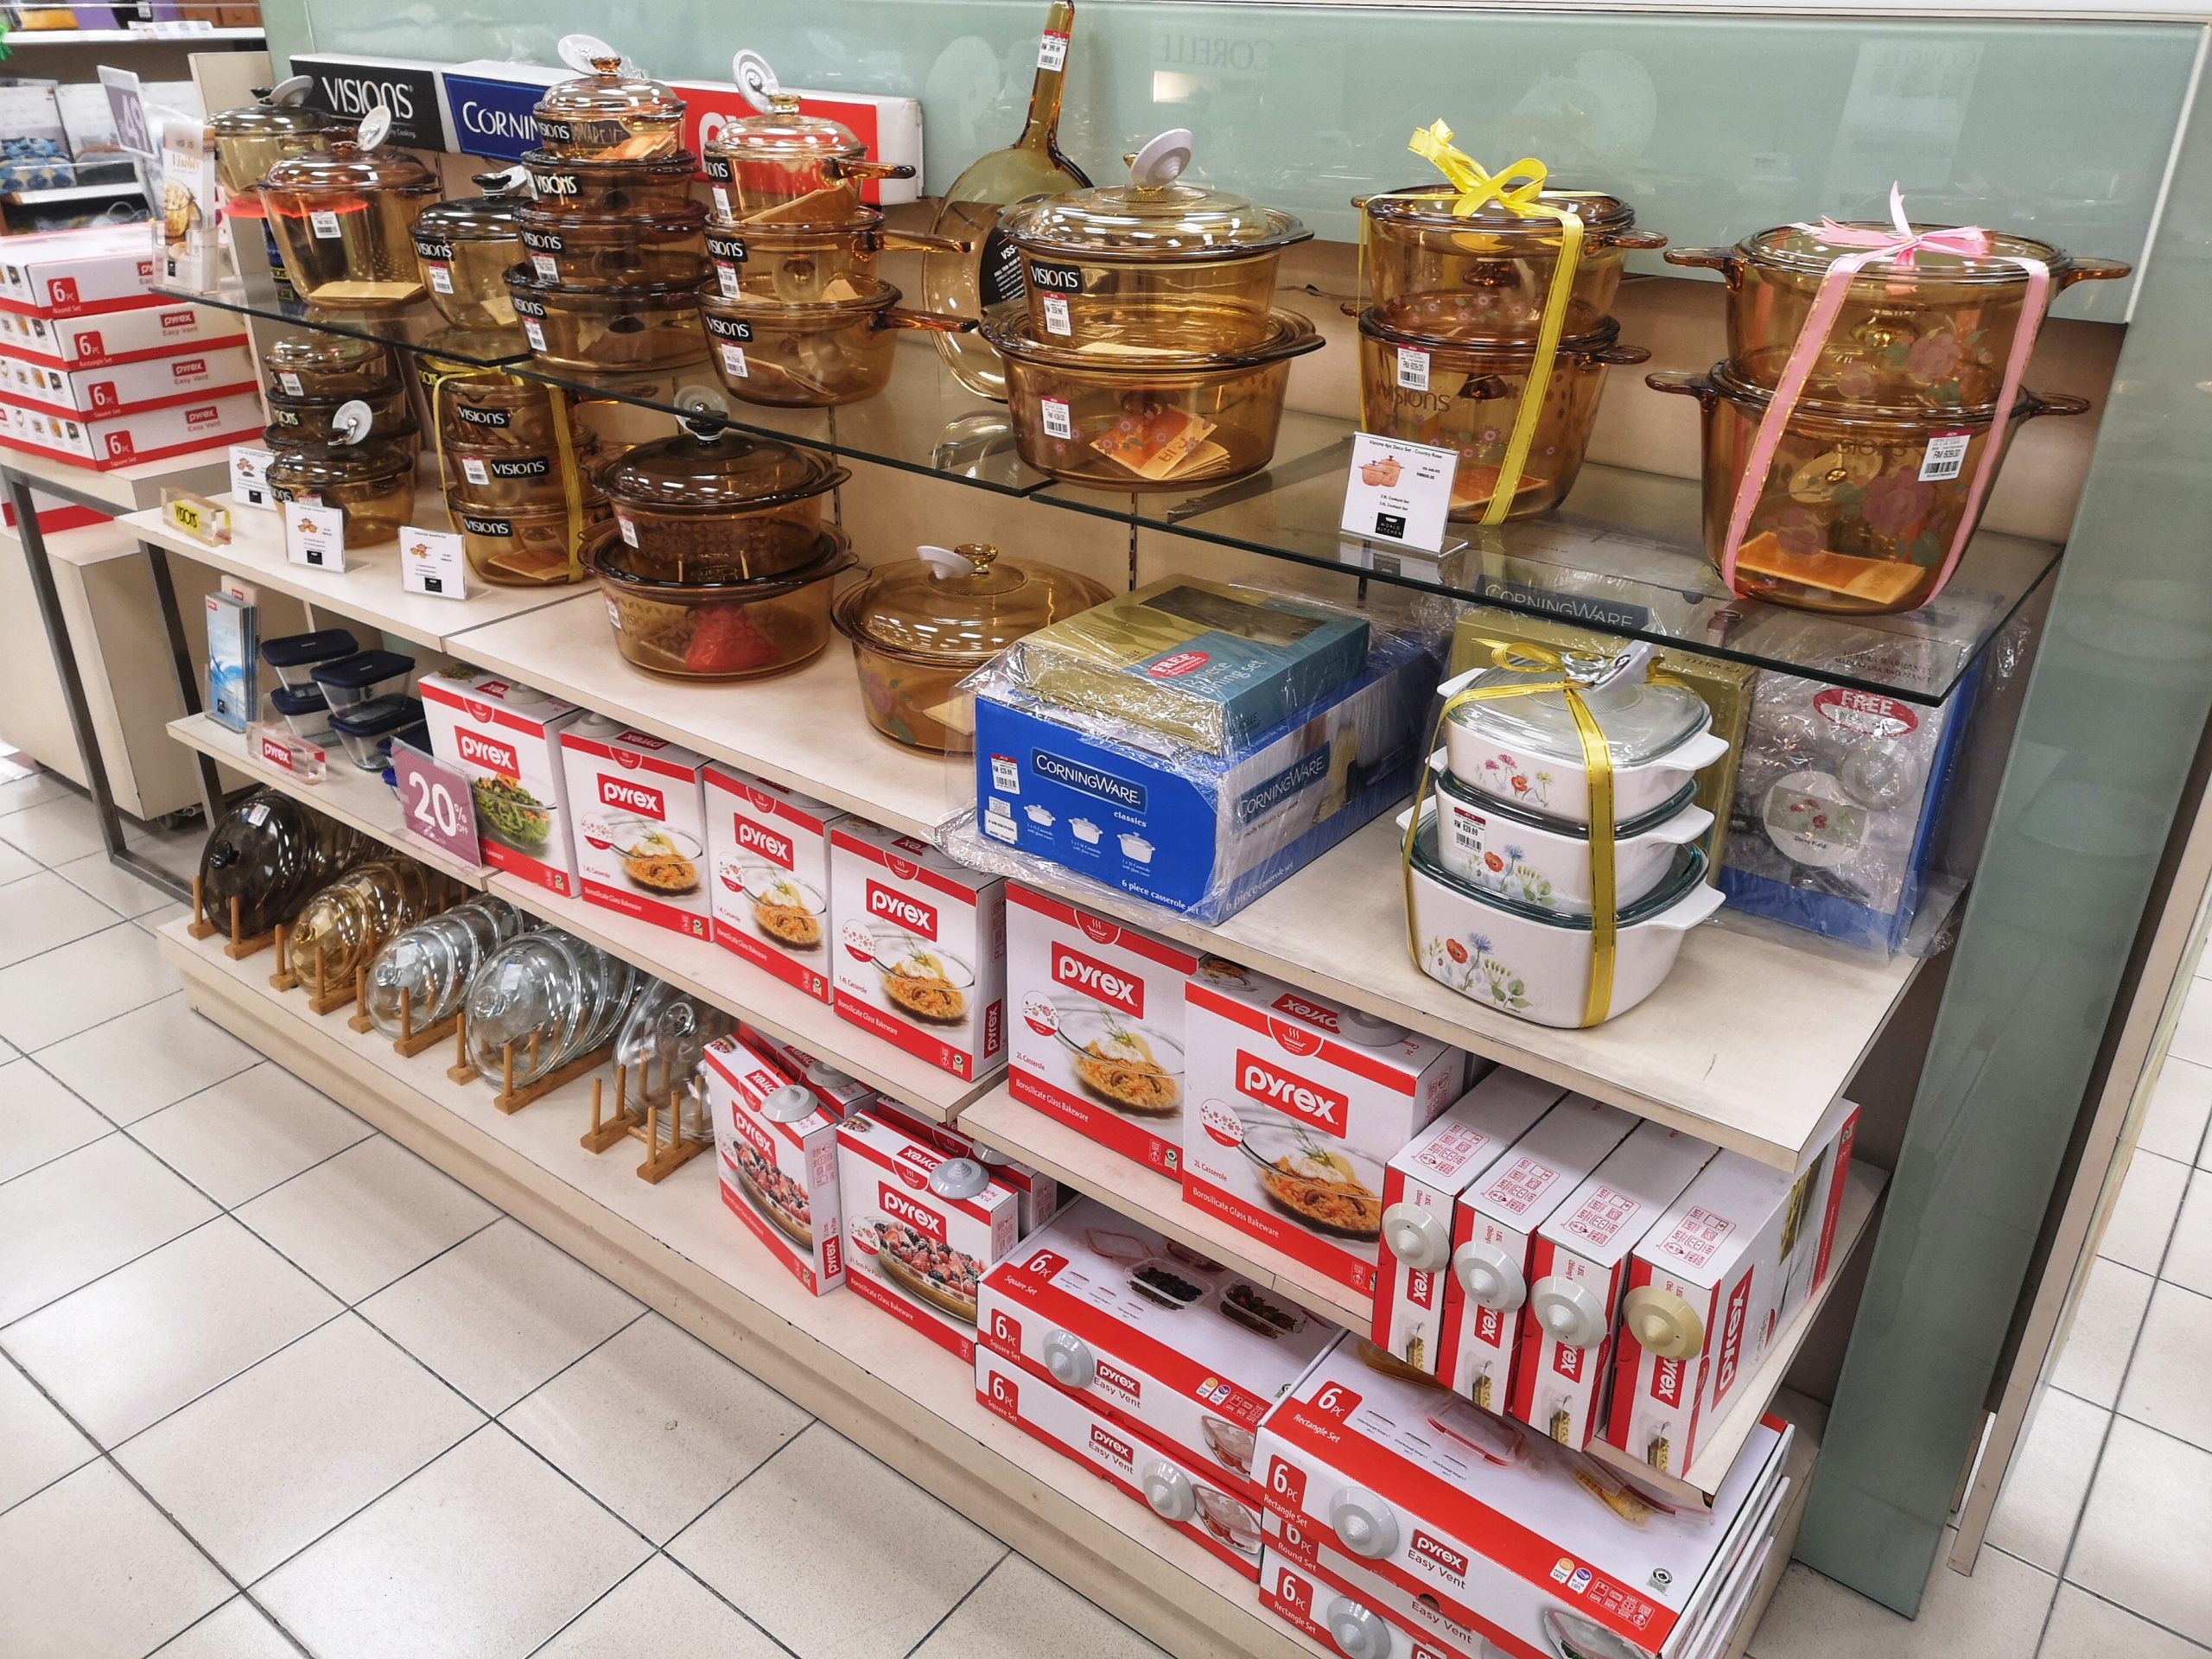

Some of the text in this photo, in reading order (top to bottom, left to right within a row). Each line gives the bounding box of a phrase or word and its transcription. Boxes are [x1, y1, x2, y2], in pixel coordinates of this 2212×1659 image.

[321, 77, 413, 119] VISIONS
[533, 174, 577, 194] VISIONS
[52, 281, 66, 303] 6
[1030, 265, 1078, 288] VISIONS
[163, 312, 193, 327] pyrex
[705, 316, 749, 338] VISIONS
[79, 335, 92, 356] 6
[175, 362, 204, 375] pyrex
[93, 385, 105, 406] 6
[188, 409, 216, 423] pyrex
[458, 406, 506, 425] VISIONS
[110, 435, 122, 455] 6
[492, 460, 546, 476] VISIONS
[464, 518, 509, 535] VISIONS
[1151, 652, 1197, 674] FREE
[1249, 659, 1268, 673] set
[1841, 690, 1895, 715] FREE
[264, 742, 292, 765] pyrex
[461, 735, 515, 770] pyrex
[1036, 754, 1141, 805] CORNINGWARE
[409, 772, 457, 837] 20
[603, 781, 661, 813] pyrex
[1114, 810, 1147, 828] classics
[739, 822, 791, 861] pyrex
[872, 889, 933, 931] pyrex
[1121, 879, 1199, 915] 6 piece casserole set
[1058, 954, 1137, 1007] pyrex
[837, 998, 899, 1037] Borosilicate Glass Bakeware
[987, 1007, 999, 1052] pyrex
[1015, 1052, 1046, 1071] 2L Casserole
[1015, 1078, 1089, 1122] Borosilicate Glass Bakeware
[1244, 1065, 1338, 1126] pyrex
[735, 1111, 772, 1157] pyrex
[1193, 1159, 1228, 1183] 2L Casserole
[884, 1192, 941, 1235] pyrex
[1192, 1186, 1280, 1238] Borosilicate Glass Bakeware
[826, 1241, 839, 1274] pyrex
[1029, 1254, 1052, 1272] 6
[1004, 1274, 1038, 1295] Square Set
[1414, 1271, 1430, 1303] rex
[995, 1315, 1016, 1347] 6 PC
[1481, 1307, 1498, 1341] rex
[1719, 1282, 1748, 1392] pyrex
[989, 1338, 1021, 1363] Square Set
[1560, 1344, 1580, 1376] rex
[993, 1376, 1014, 1408] 6 PC
[1094, 1376, 1141, 1410] Easy Vent
[1099, 1364, 1136, 1393] pyrex
[988, 1399, 1018, 1423] Square Set
[1318, 1388, 1345, 1419] 6 PC
[1094, 1429, 1129, 1456] pyrex
[1293, 1413, 1341, 1445] Rectangle Set
[1088, 1440, 1135, 1475] Easy Vent
[1273, 1463, 1299, 1503] 6 PC
[1263, 1493, 1308, 1529] Rectangle Set
[1286, 1522, 1312, 1555] 6 PC
[1416, 1535, 1462, 1570] pyrex
[1278, 1541, 1317, 1573] Round Set
[1407, 1549, 1466, 1590] Easy Vent
[1282, 1575, 1306, 1611] 6 PC
[1274, 1600, 1317, 1636] Rectangle Set
[1411, 1600, 1472, 1644] Easy Vent
